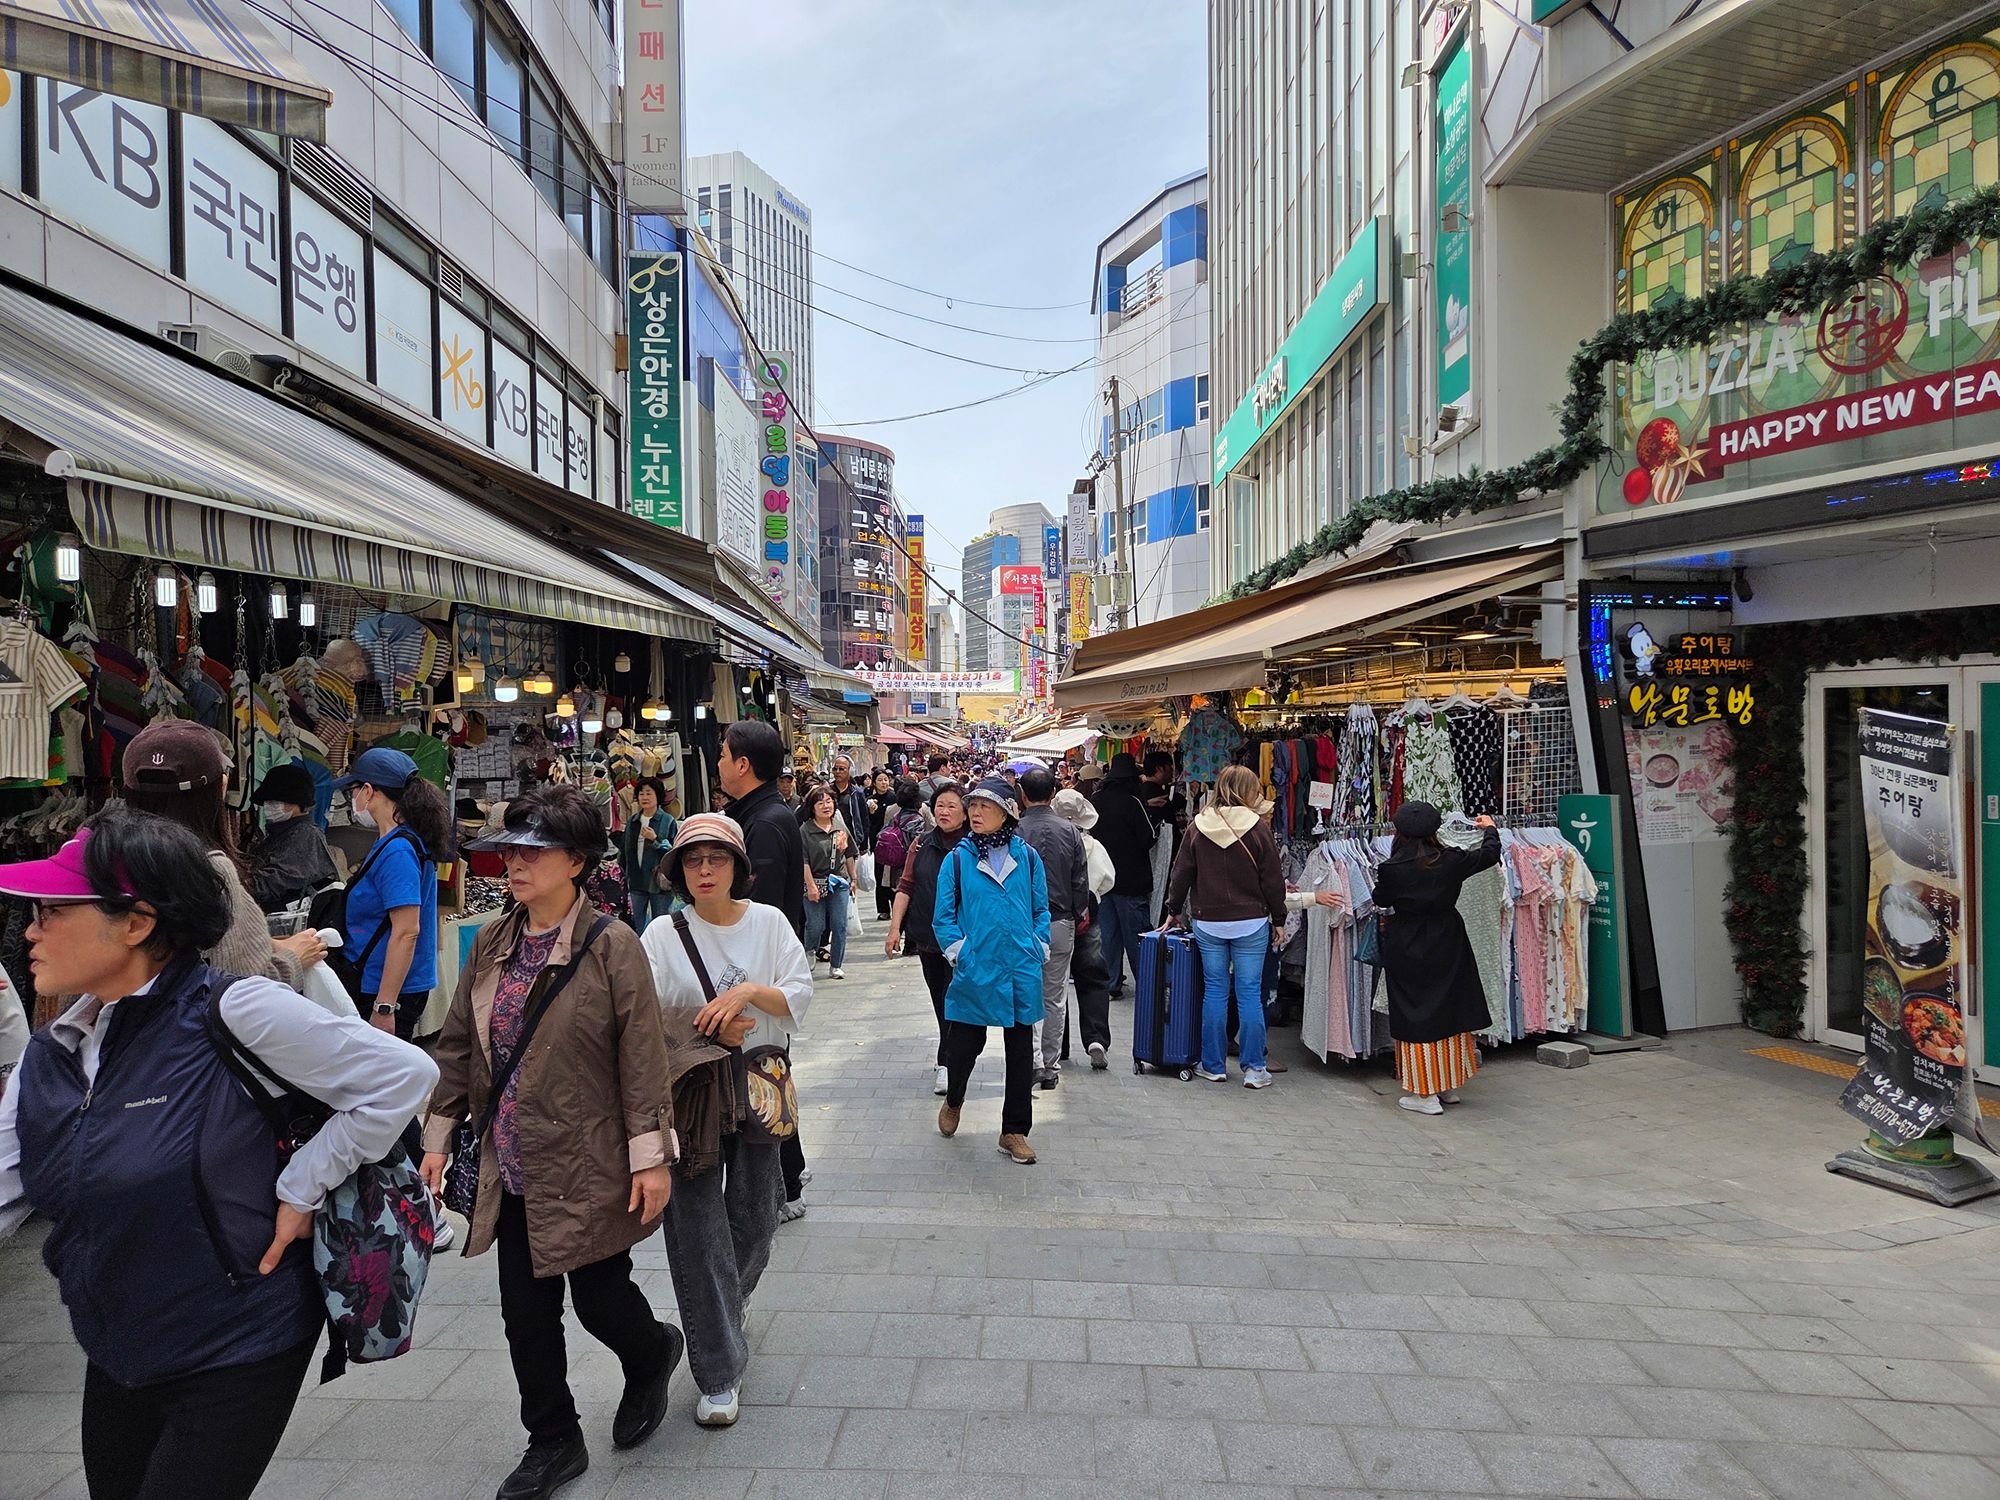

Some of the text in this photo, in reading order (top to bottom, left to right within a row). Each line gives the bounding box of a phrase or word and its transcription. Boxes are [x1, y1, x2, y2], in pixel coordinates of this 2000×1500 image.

[639, 0, 664, 112] 패션
[1776, 135, 1804, 177] 나
[1928, 68, 1964, 119] 은
[641, 133, 668, 154] 1F
[631, 175, 677, 187] fashion
[632, 162, 677, 171] women
[48, 78, 357, 334] KB 국민은행
[1654, 326, 1798, 409] BUZZA
[492, 370, 588, 480] KB 국민은행
[1720, 408, 1827, 456] HAPPY
[1837, 388, 1916, 428] NEW
[850, 455, 876, 480] 남대문
[634, 498, 679, 520] 렌즈
[1071, 504, 1087, 557] 미용재료
[909, 541, 924, 652] 그릇도매상가
[1681, 635, 1733, 655] 추어탕
[1129, 686, 1148, 696] BUZZA
[1879, 786, 1924, 819] 추어탕
[1870, 1101, 1921, 1139] 02)778-672
